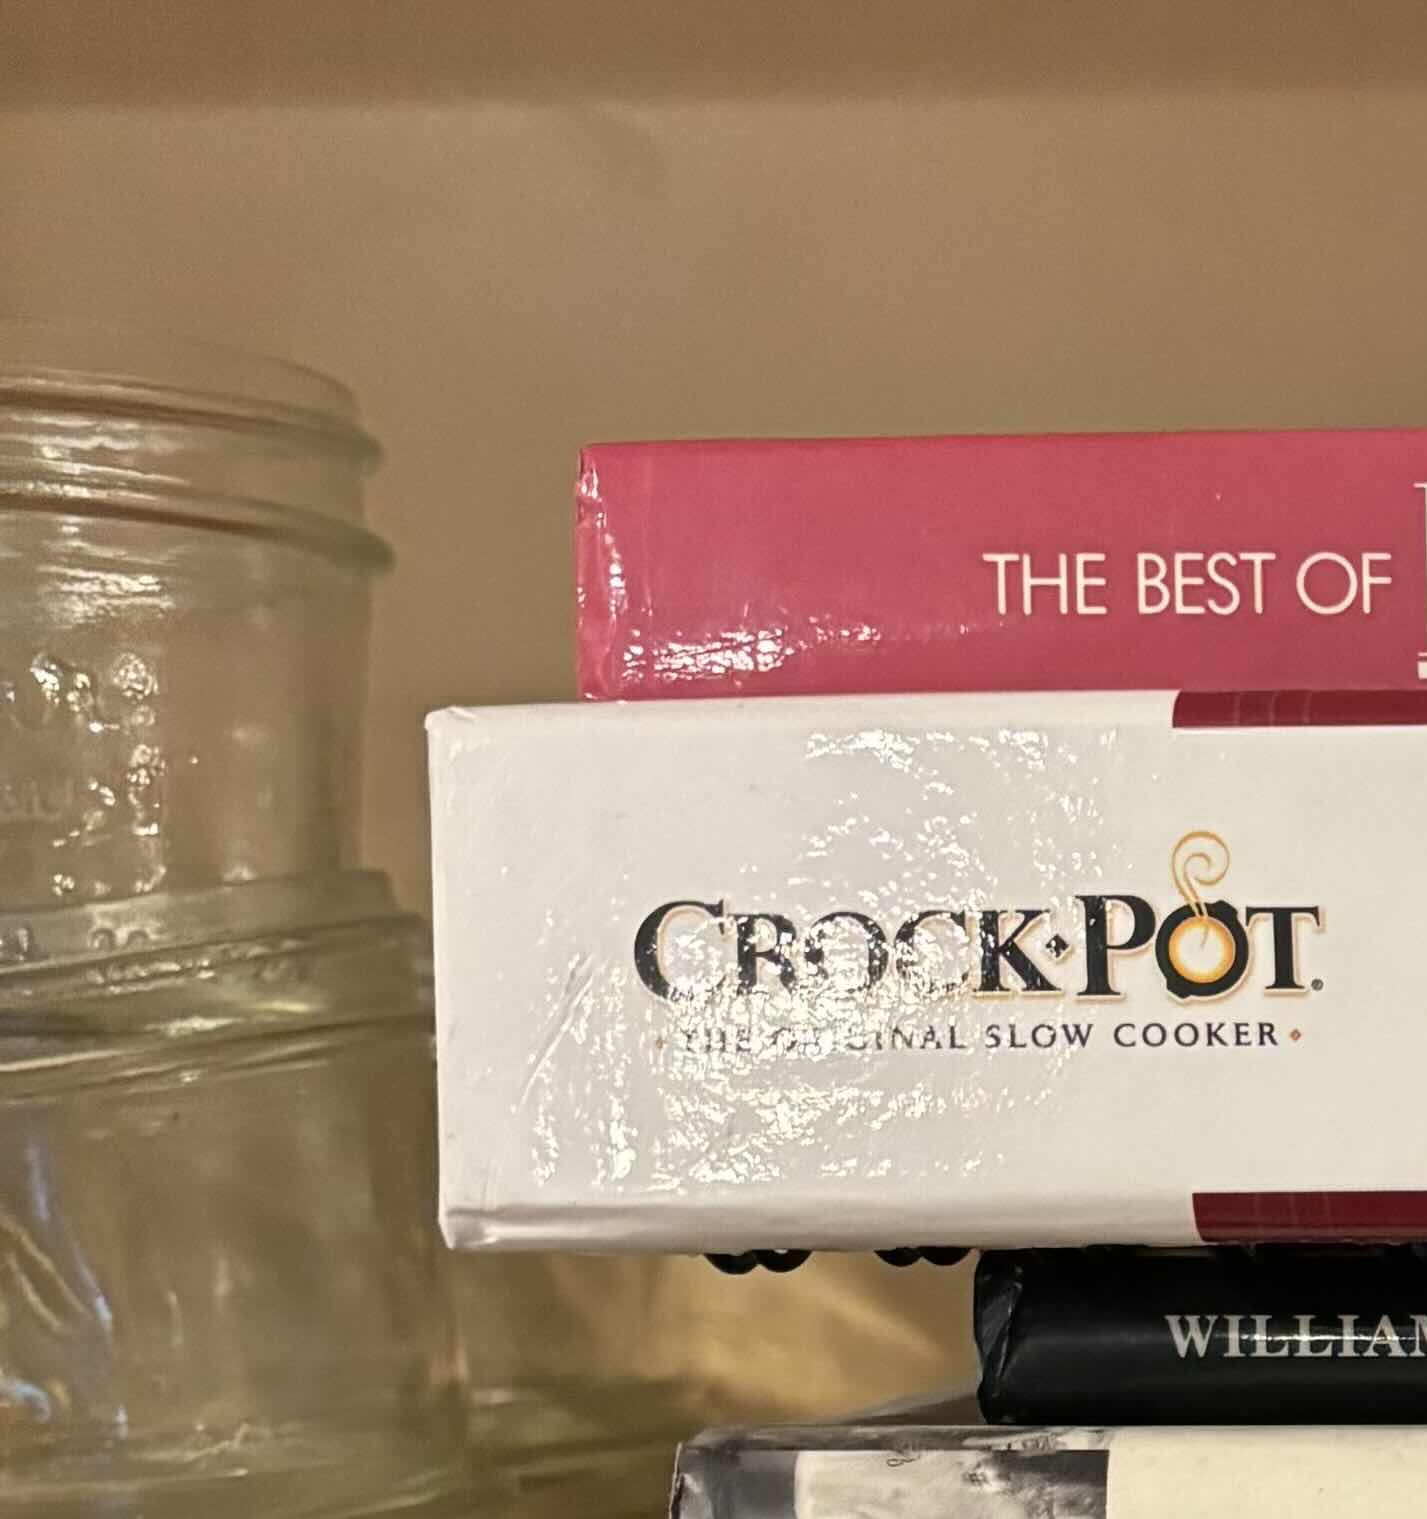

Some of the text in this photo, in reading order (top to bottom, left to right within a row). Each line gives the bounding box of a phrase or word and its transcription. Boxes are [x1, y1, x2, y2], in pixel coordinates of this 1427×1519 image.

[983, 552, 1108, 617] THE
[1136, 552, 1276, 616] BEST
[1295, 551, 1393, 615] OF
[771, 1023, 967, 1052] OGINAL
[984, 1022, 1093, 1049] SLOW
[1113, 1021, 1279, 1048] COOKER
